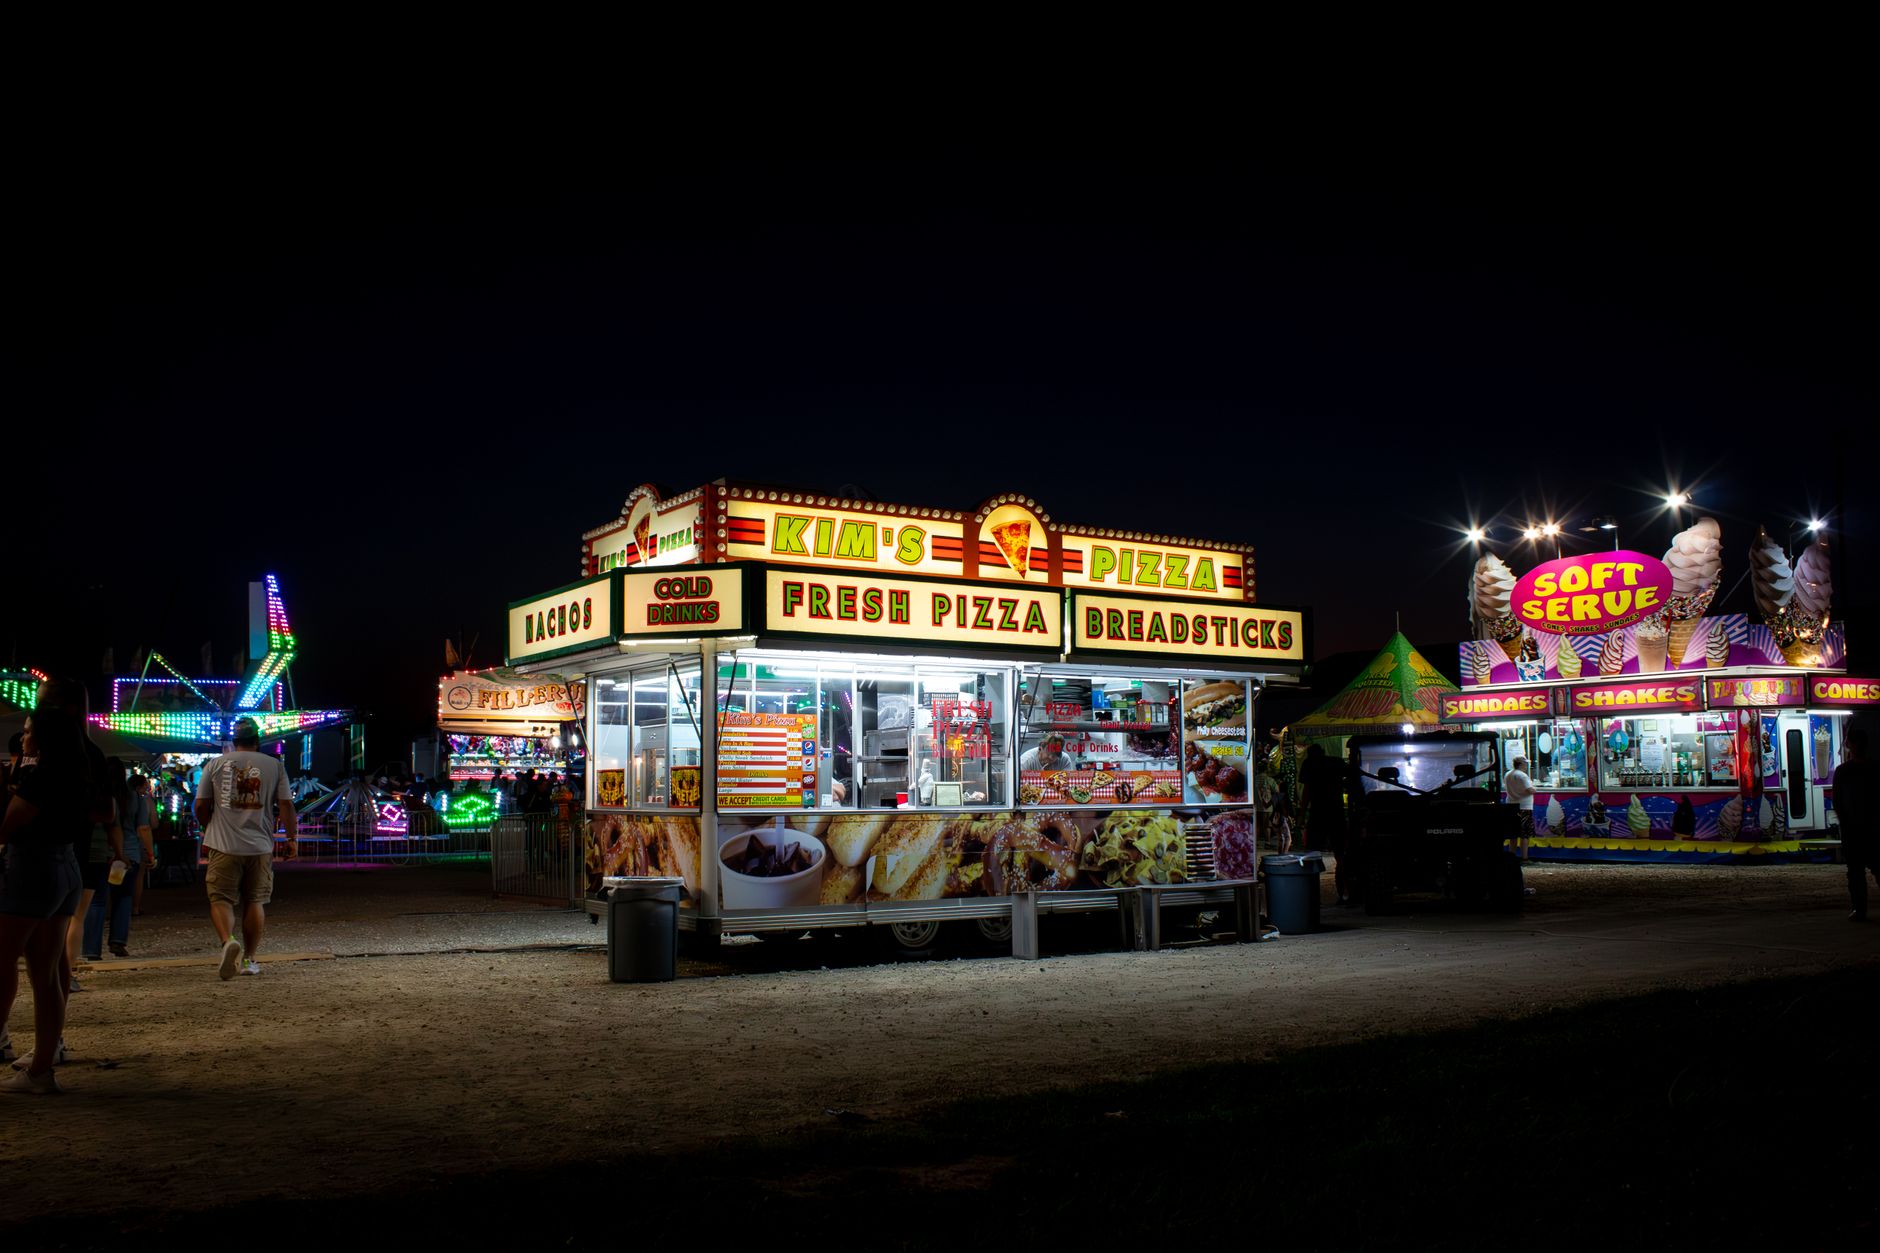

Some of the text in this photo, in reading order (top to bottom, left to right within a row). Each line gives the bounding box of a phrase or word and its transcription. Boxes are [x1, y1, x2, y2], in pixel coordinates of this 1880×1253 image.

[600, 527, 692, 573] KIM'S PIZZA
[771, 512, 1218, 593] KIM'S PIZZA
[653, 576, 713, 600] COLD
[1533, 562, 1644, 597] SOFT
[646, 600, 720, 626] DRINKS
[782, 580, 1048, 634] FRESH PIZZA
[1521, 586, 1660, 621] SERVE
[525, 597, 592, 644] NACHOS
[1085, 606, 1293, 650] BREADSTICKS
[1541, 612, 1640, 633] CONES SHAKES SUNDAES
[1574, 684, 1698, 708] SHAKES
[1814, 682, 1880, 700] CONES
[931, 699, 993, 719] FRESH
[1045, 703, 1083, 716] PIZZA
[1445, 694, 1547, 715] SUNDAES
[932, 719, 993, 741] PIZZA
[1065, 742, 1086, 753] Cold
[1089, 742, 1119, 753] Drinks
[719, 796, 729, 805] WE
[729, 796, 752, 805] ACCEPT
